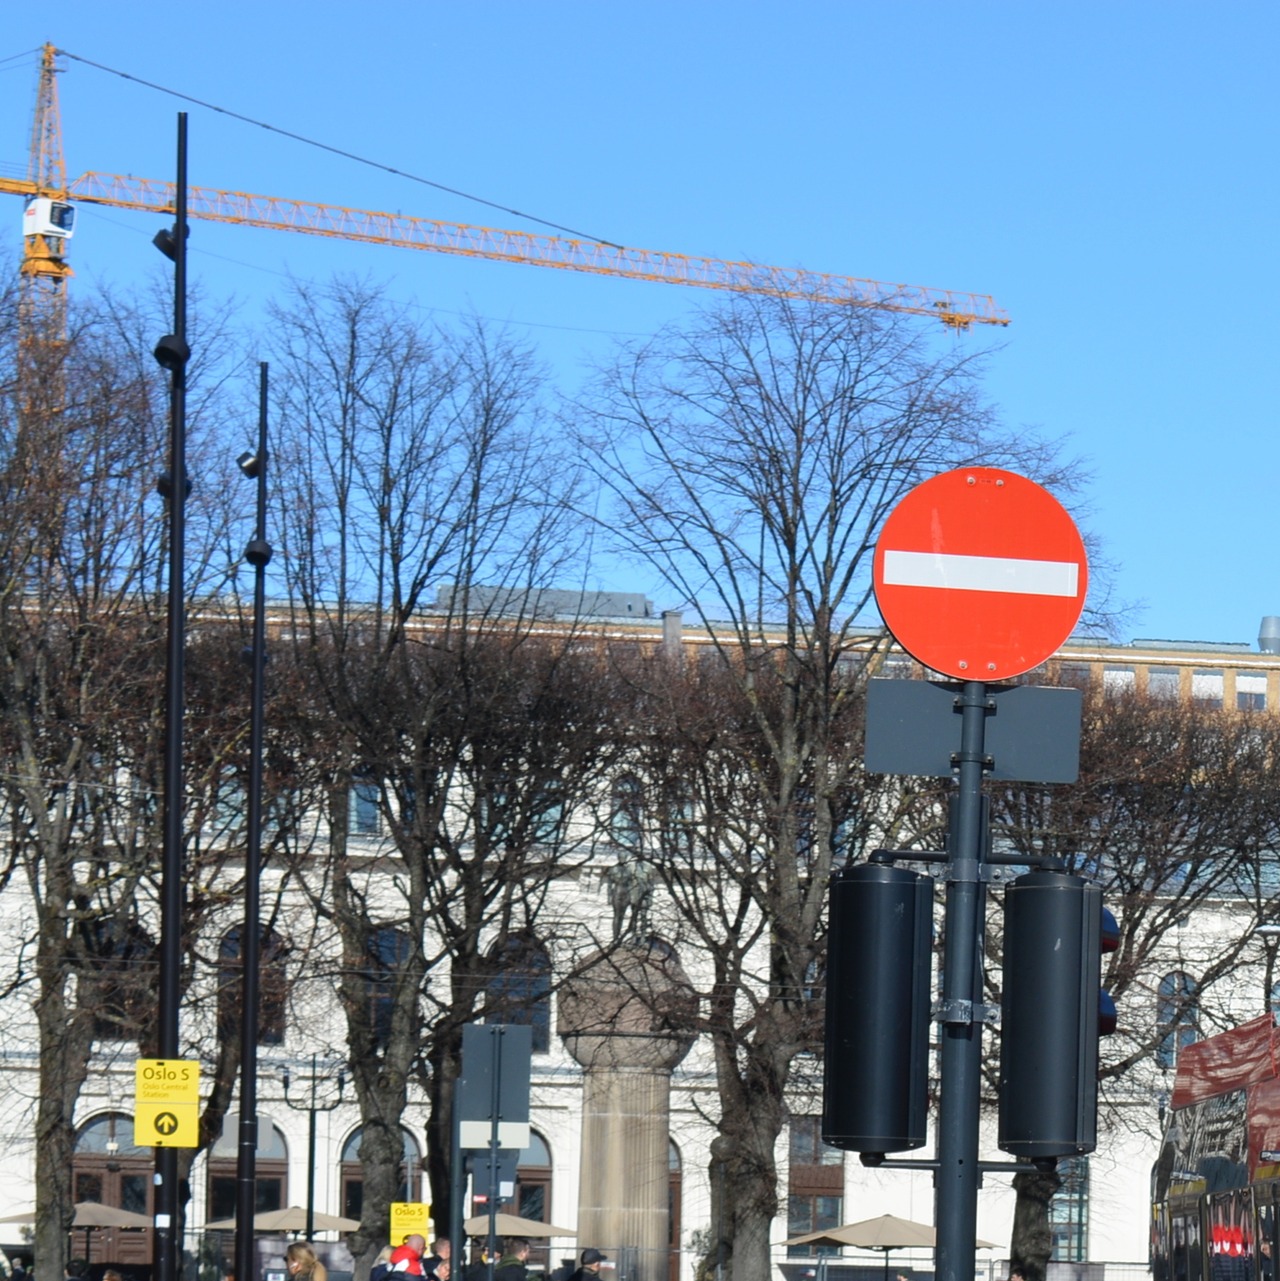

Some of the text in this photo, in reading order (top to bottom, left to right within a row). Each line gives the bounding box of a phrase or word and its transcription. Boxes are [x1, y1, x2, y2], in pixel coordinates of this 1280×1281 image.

[143, 1067, 190, 1081] Oslo S
[142, 1082, 160, 1090] Oslo
[395, 1207, 416, 1216] Oslo
